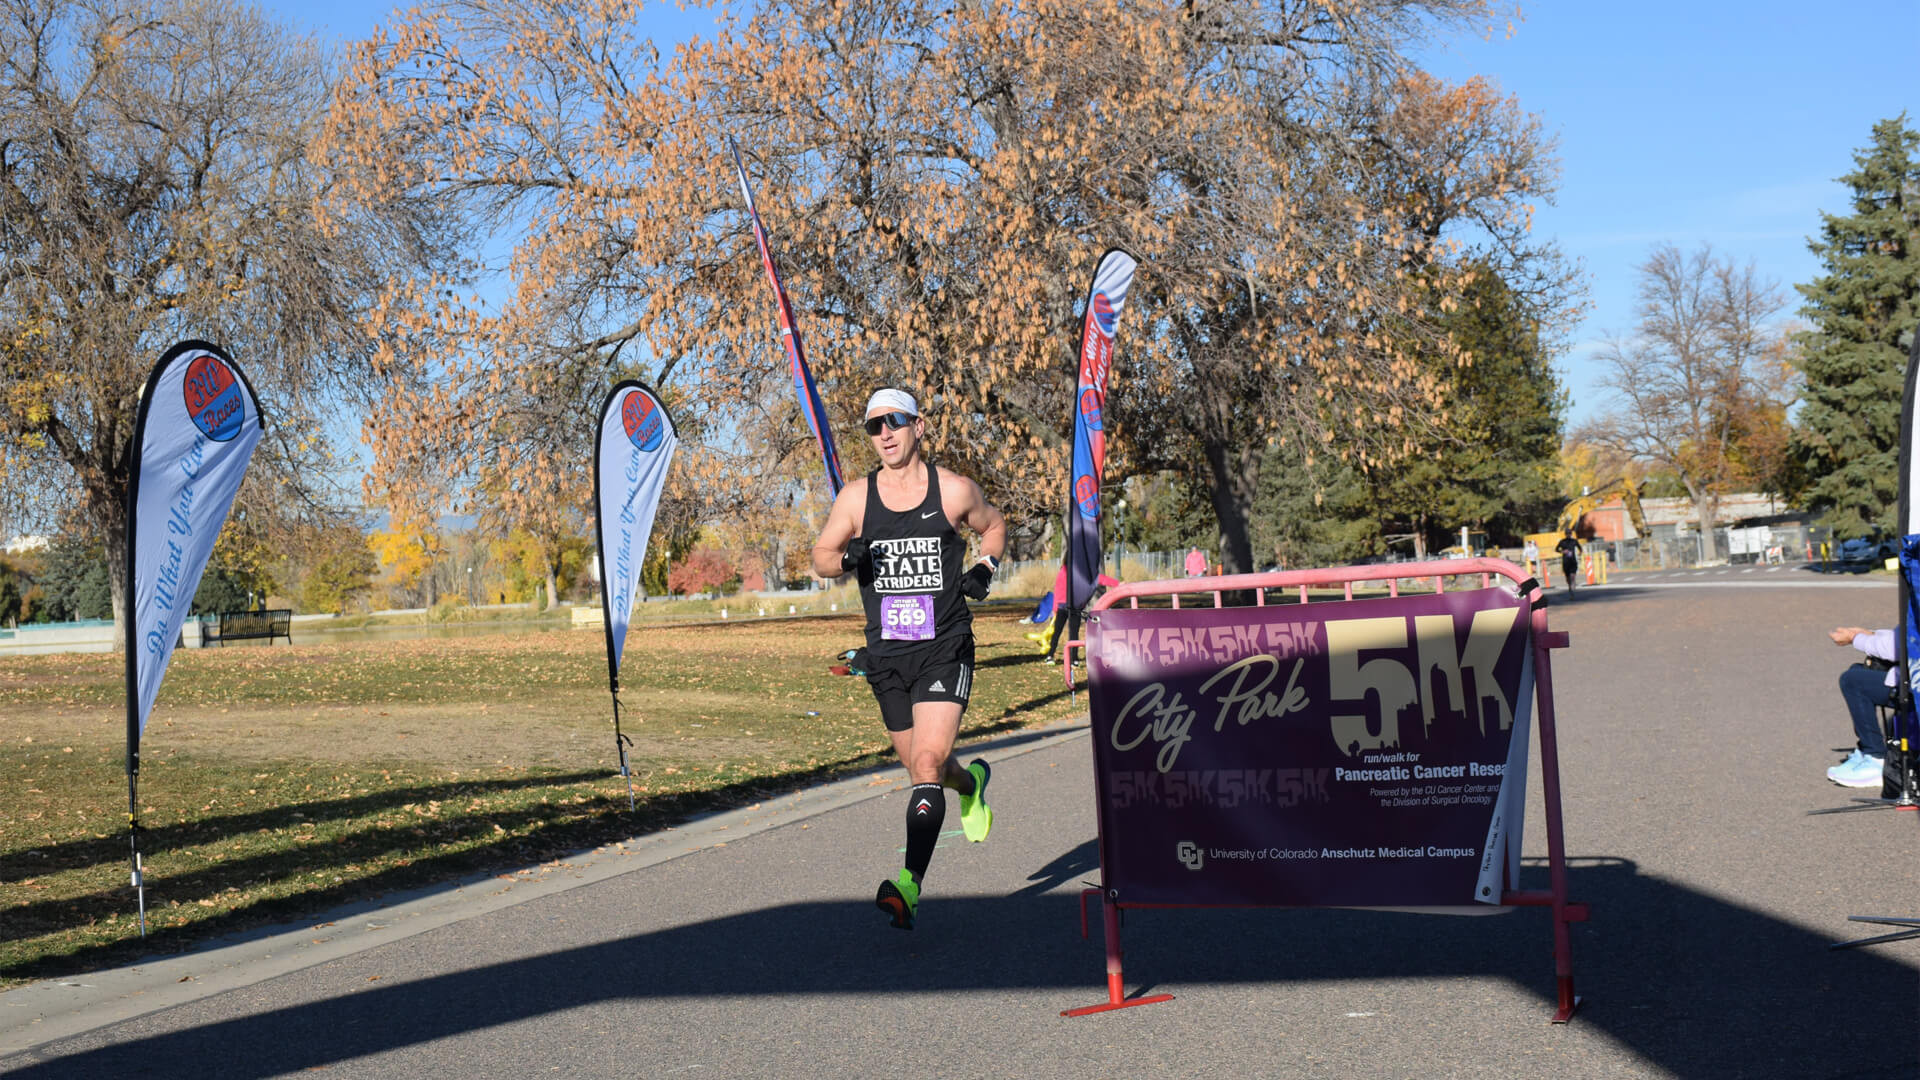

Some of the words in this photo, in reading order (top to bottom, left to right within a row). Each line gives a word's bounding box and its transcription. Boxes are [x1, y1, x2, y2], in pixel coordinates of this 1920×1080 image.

[188, 361, 221, 407] 3W
[203, 395, 240, 433] Races
[636, 416, 660, 448] Races
[181, 434, 205, 479] Can
[625, 449, 640, 482] Can
[168, 486, 194, 536] You
[616, 528, 631, 579] What
[874, 556, 941, 575] STATE
[155, 540, 182, 610] What
[874, 574, 941, 588] STRIDERS
[616, 588, 627, 616] Do
[887, 608, 925, 626] 569
[147, 619, 168, 661] Do
[1101, 628, 1154, 668] 5K
[1158, 627, 1210, 666] 5K
[1208, 624, 1264, 664] 5K
[1265, 621, 1320, 660] 5K
[1325, 607, 1520, 757] 5K
[1111, 682, 1196, 773] City
[1199, 654, 1310, 732] Park
[1335, 766, 1410, 782] Pancreatic
[1413, 764, 1466, 780] Cancer
[1364, 752, 1405, 764] run/walk
[1406, 752, 1420, 763] for
[1112, 771, 1159, 808] 5K
[1163, 770, 1216, 808] 5K
[1217, 769, 1272, 808] 5K
[1277, 768, 1330, 808] 5K
[1370, 786, 1400, 797] Powered
[1400, 786, 1410, 797] by
[1411, 785, 1423, 796] the
[1425, 785, 1436, 795] CU
[1437, 785, 1463, 795] Cancer
[1464, 783, 1487, 794] Center
[1487, 783, 1500, 793] and
[1381, 798, 1392, 808] the
[1393, 797, 1421, 807] Division
[1421, 796, 1430, 806] of
[1431, 796, 1459, 808] Surgical
[1210, 848, 1256, 861] University
[1257, 848, 1267, 859] of
[1269, 848, 1318, 859] Colorado
[1321, 847, 1375, 858] Anschutz
[1378, 846, 1424, 858] Medical
[1427, 846, 1475, 859] Campus
